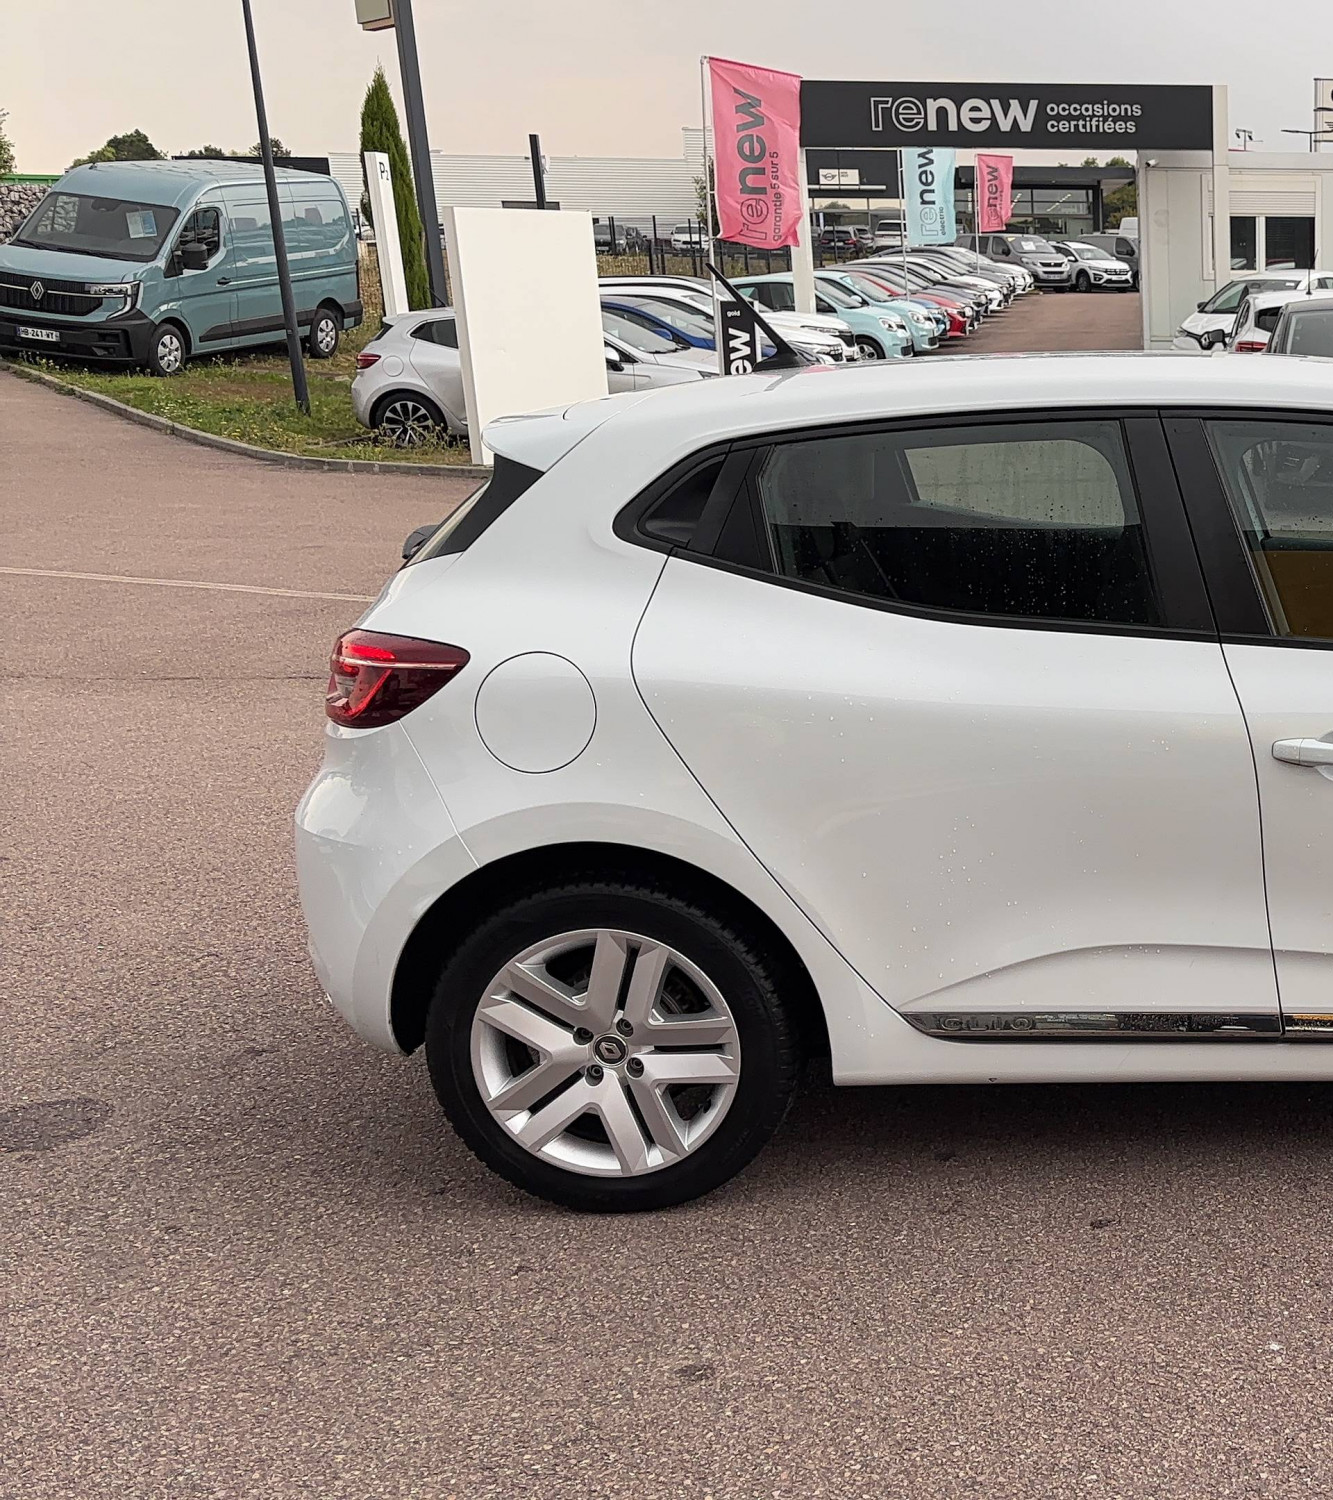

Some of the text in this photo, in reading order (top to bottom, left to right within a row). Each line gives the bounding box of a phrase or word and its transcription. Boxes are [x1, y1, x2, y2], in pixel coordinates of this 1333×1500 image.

[870, 97, 1039, 132] renew
[1046, 100, 1142, 117] occasions
[1046, 117, 1137, 133] certifiées
[733, 87, 769, 240] renew
[768, 151, 783, 242] garantie 5 sur 5
[917, 147, 939, 237] renew
[986, 165, 1003, 228] renew
[939, 206, 947, 236] electric
[727, 310, 741, 318] gold
